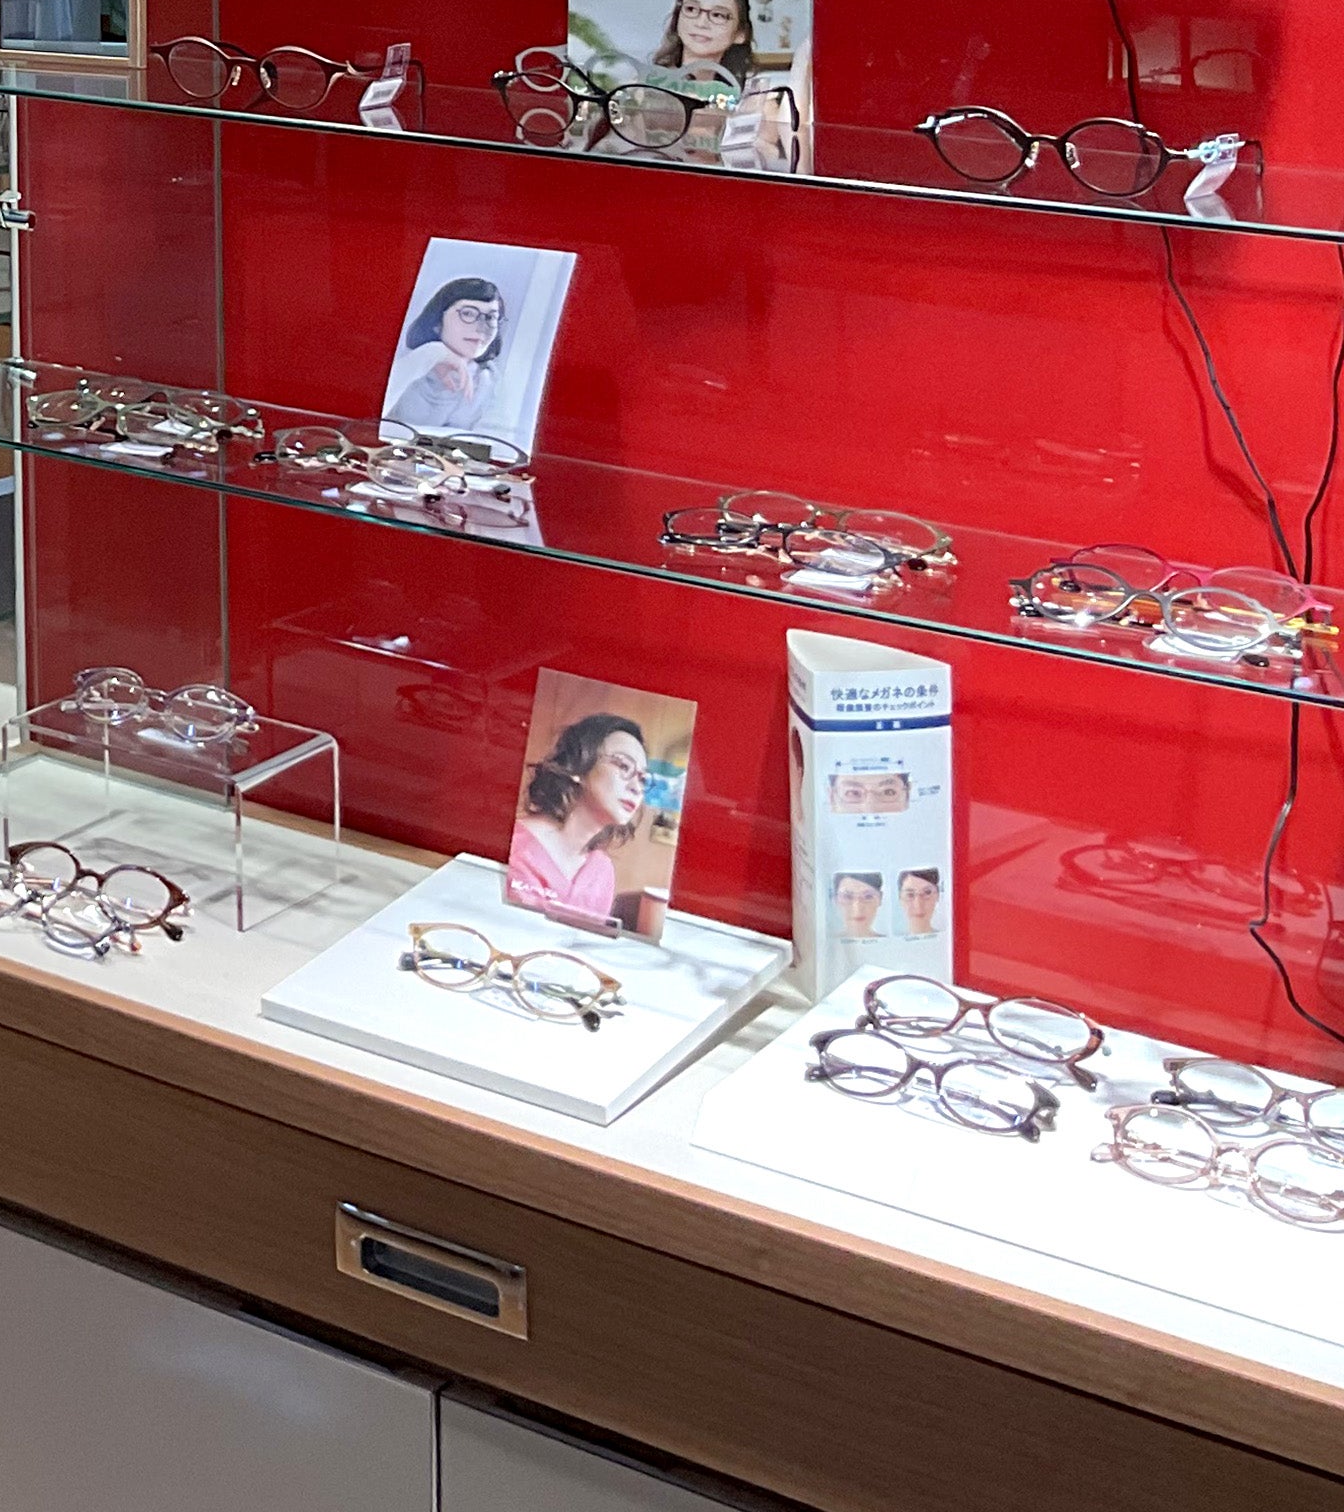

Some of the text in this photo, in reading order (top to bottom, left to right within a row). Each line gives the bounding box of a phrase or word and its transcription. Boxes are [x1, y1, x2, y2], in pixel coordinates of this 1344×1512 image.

[830, 684, 939, 701] 快適なメガネの条件
